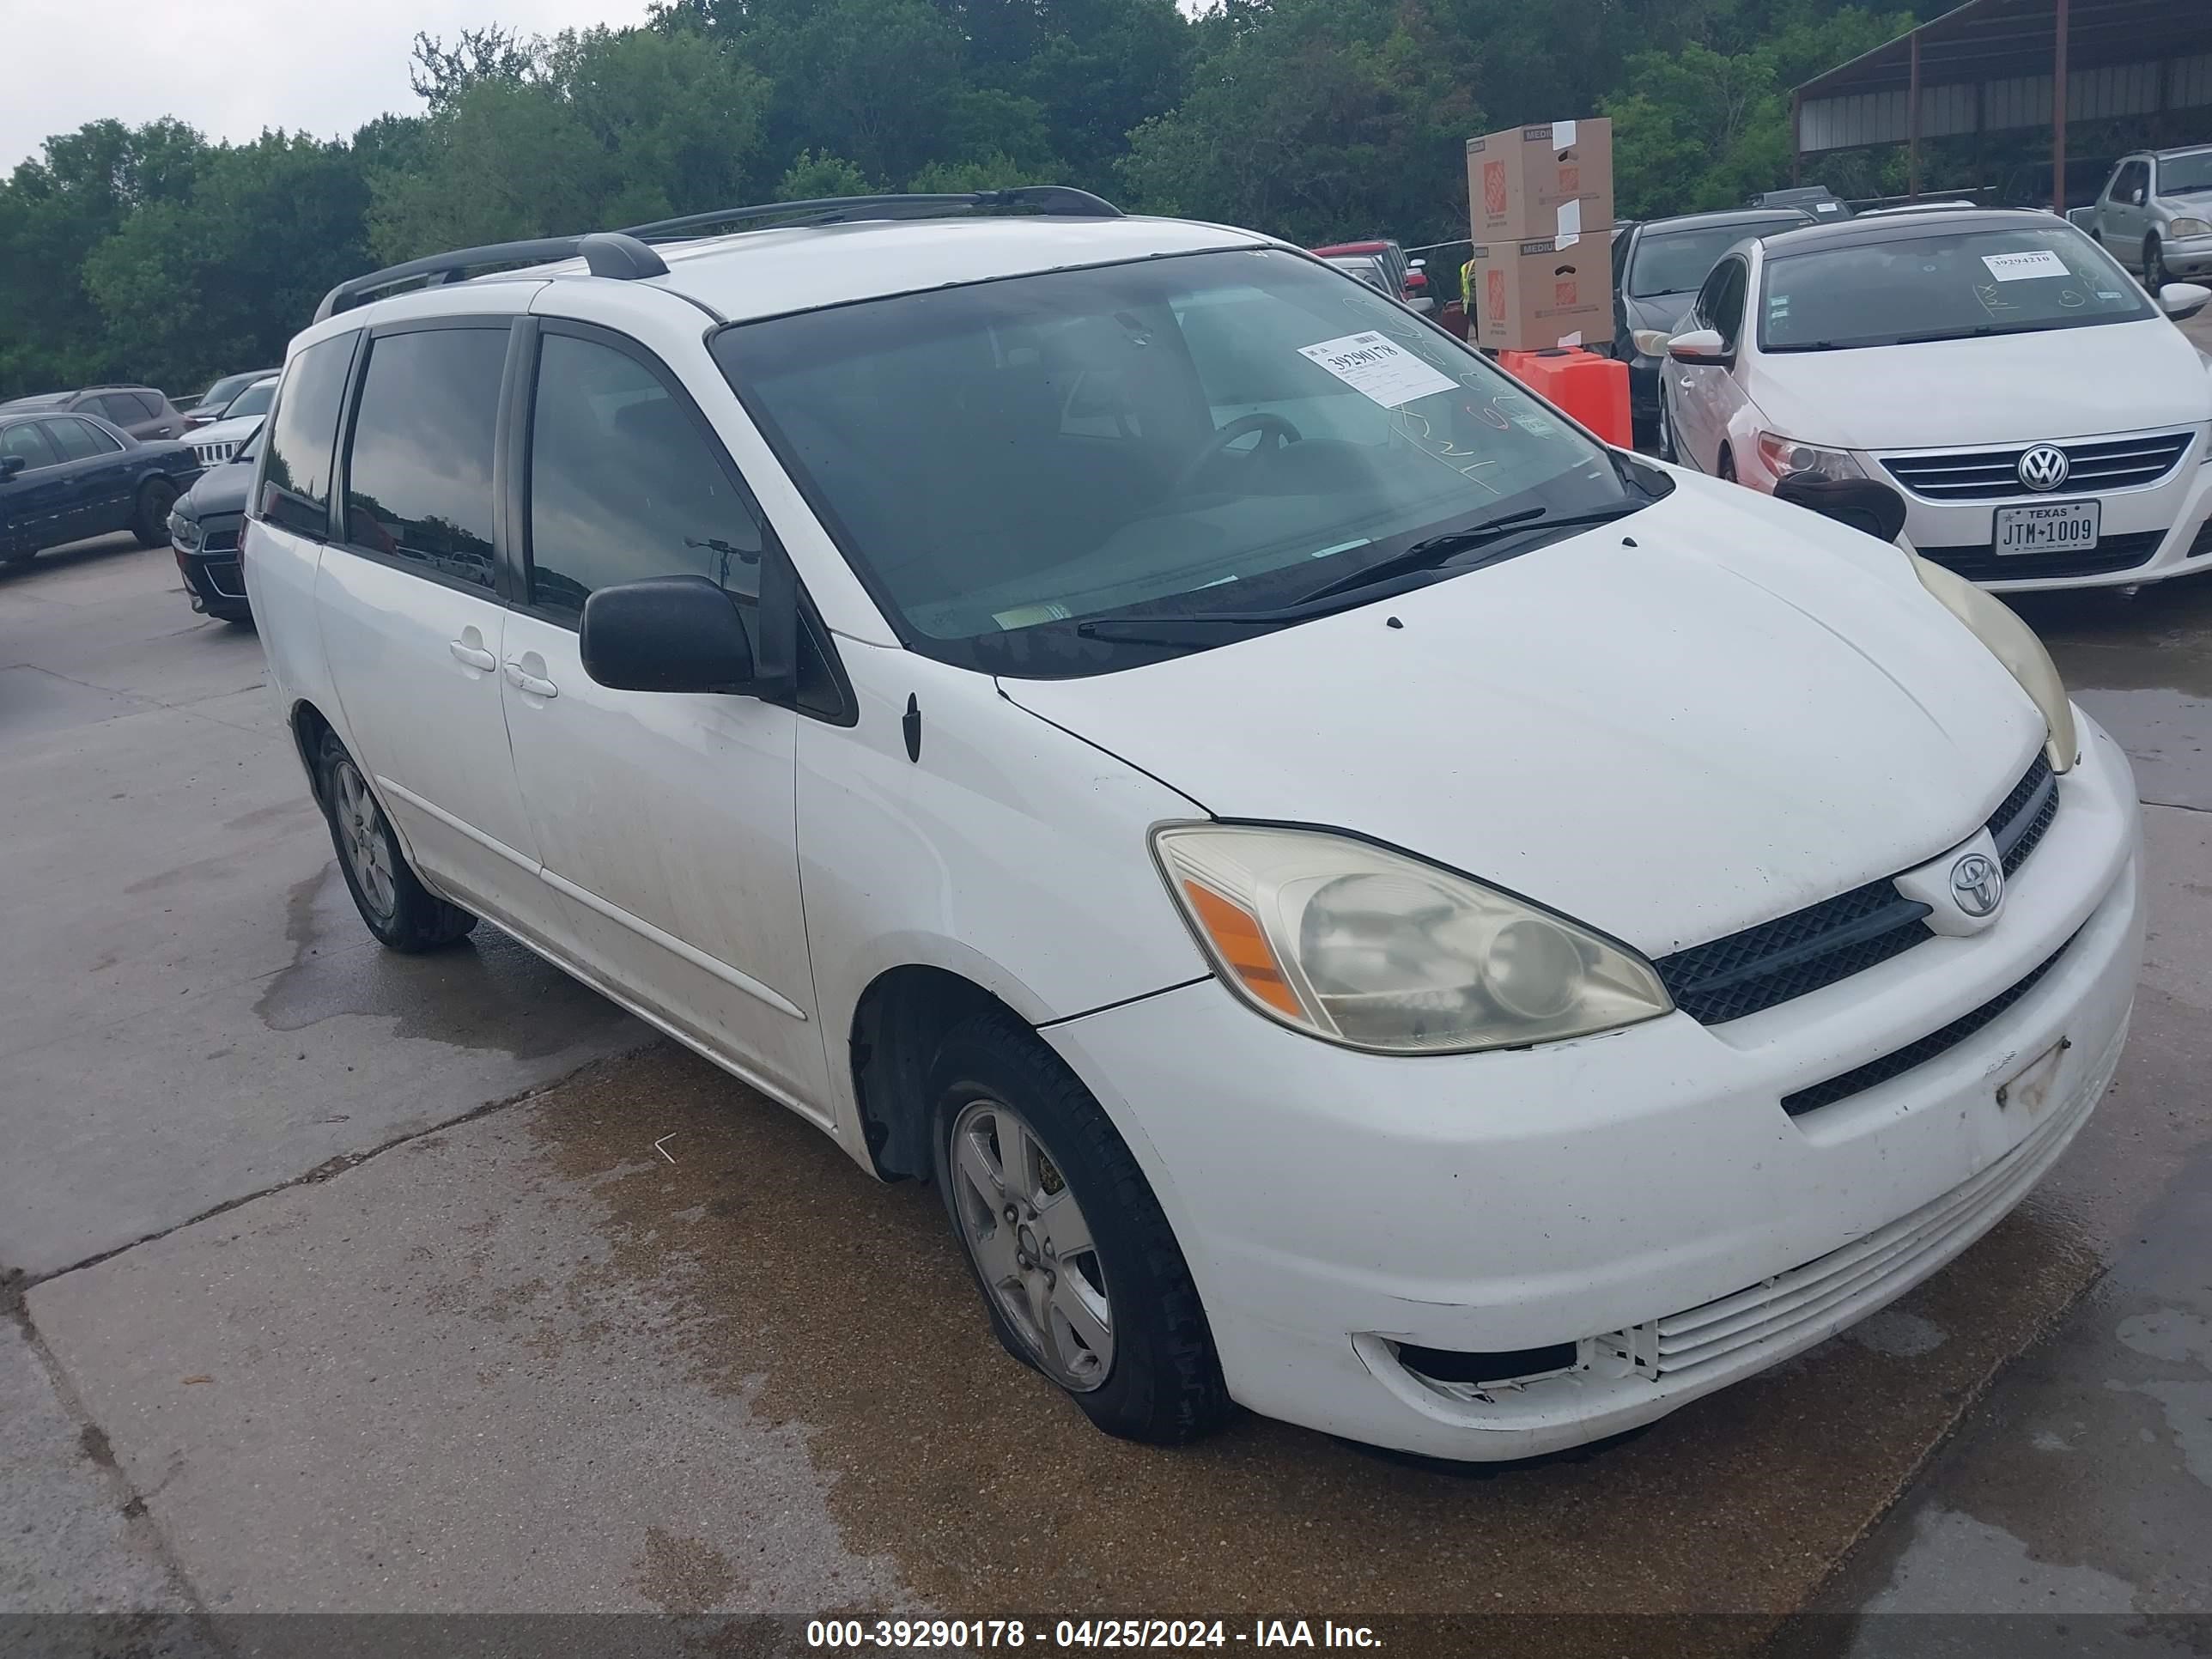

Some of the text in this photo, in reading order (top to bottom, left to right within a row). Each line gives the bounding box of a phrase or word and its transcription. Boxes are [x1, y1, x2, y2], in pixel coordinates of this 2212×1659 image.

[1526, 130, 1553, 140] MEDIU
[1523, 243, 1553, 253] MEDIU
[1328, 344, 1399, 370] 39290178
[2028, 508, 2068, 519] TEXAS
